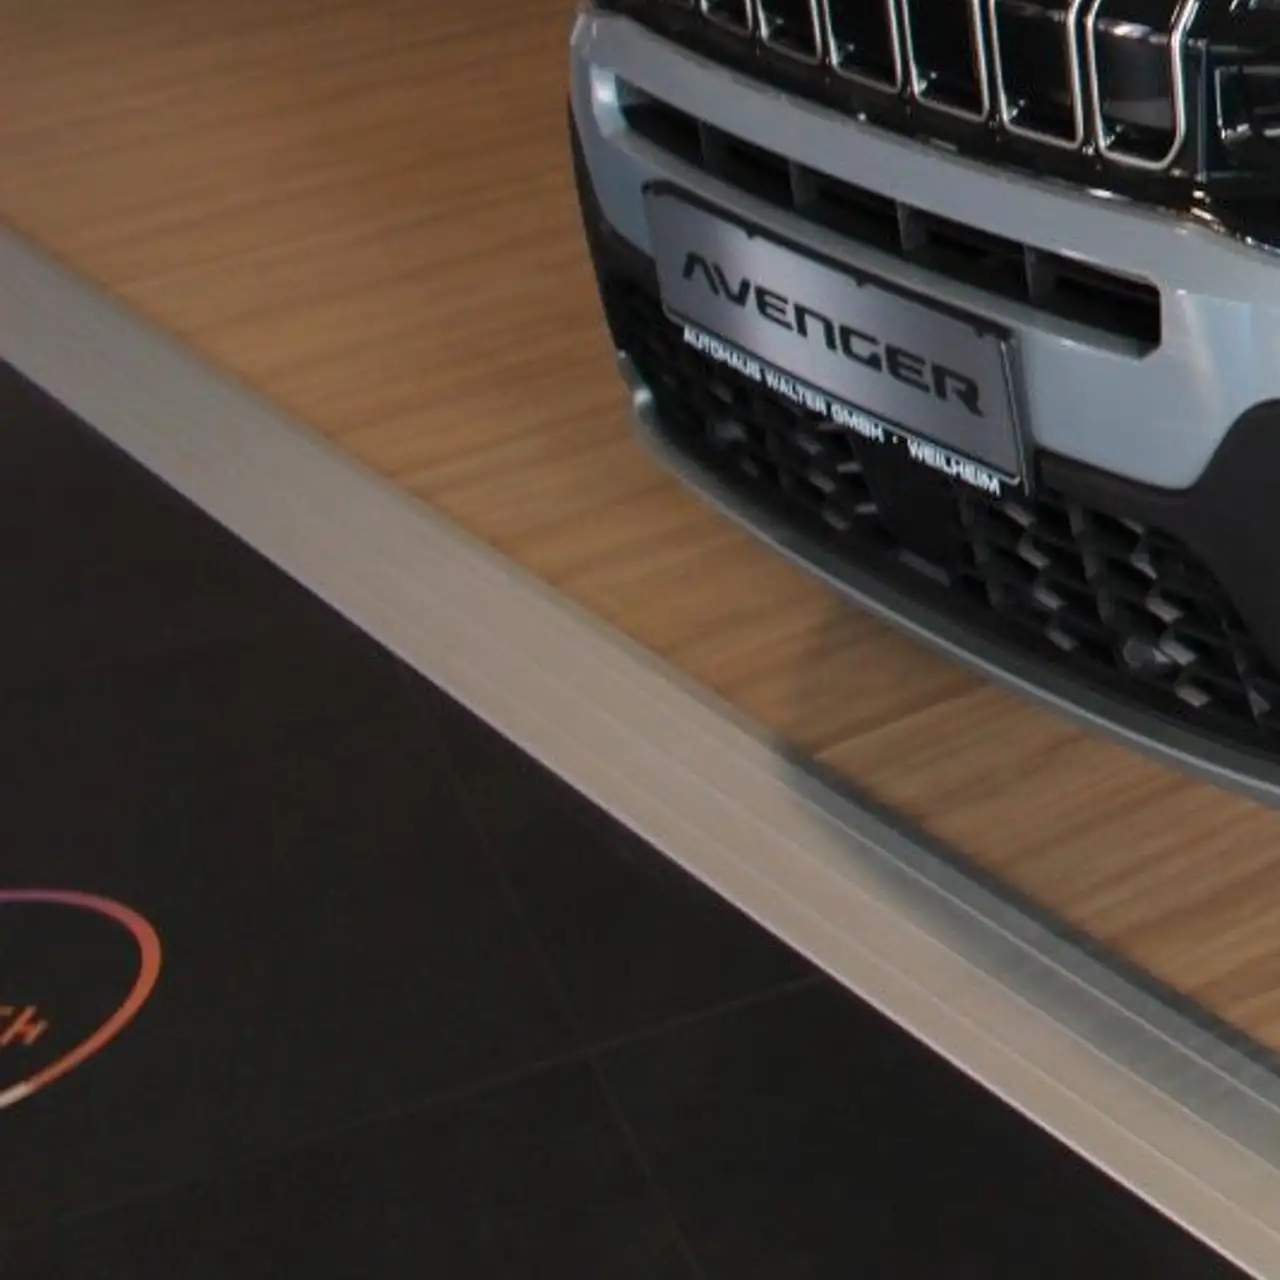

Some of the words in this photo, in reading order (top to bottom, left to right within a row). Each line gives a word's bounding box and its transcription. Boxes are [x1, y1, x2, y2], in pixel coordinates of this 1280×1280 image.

[682, 251, 984, 417] AVENGER
[683, 324, 762, 382] AUTOHAUS
[764, 370, 828, 416] WALTER
[906, 437, 1001, 497] WEILHEIM
